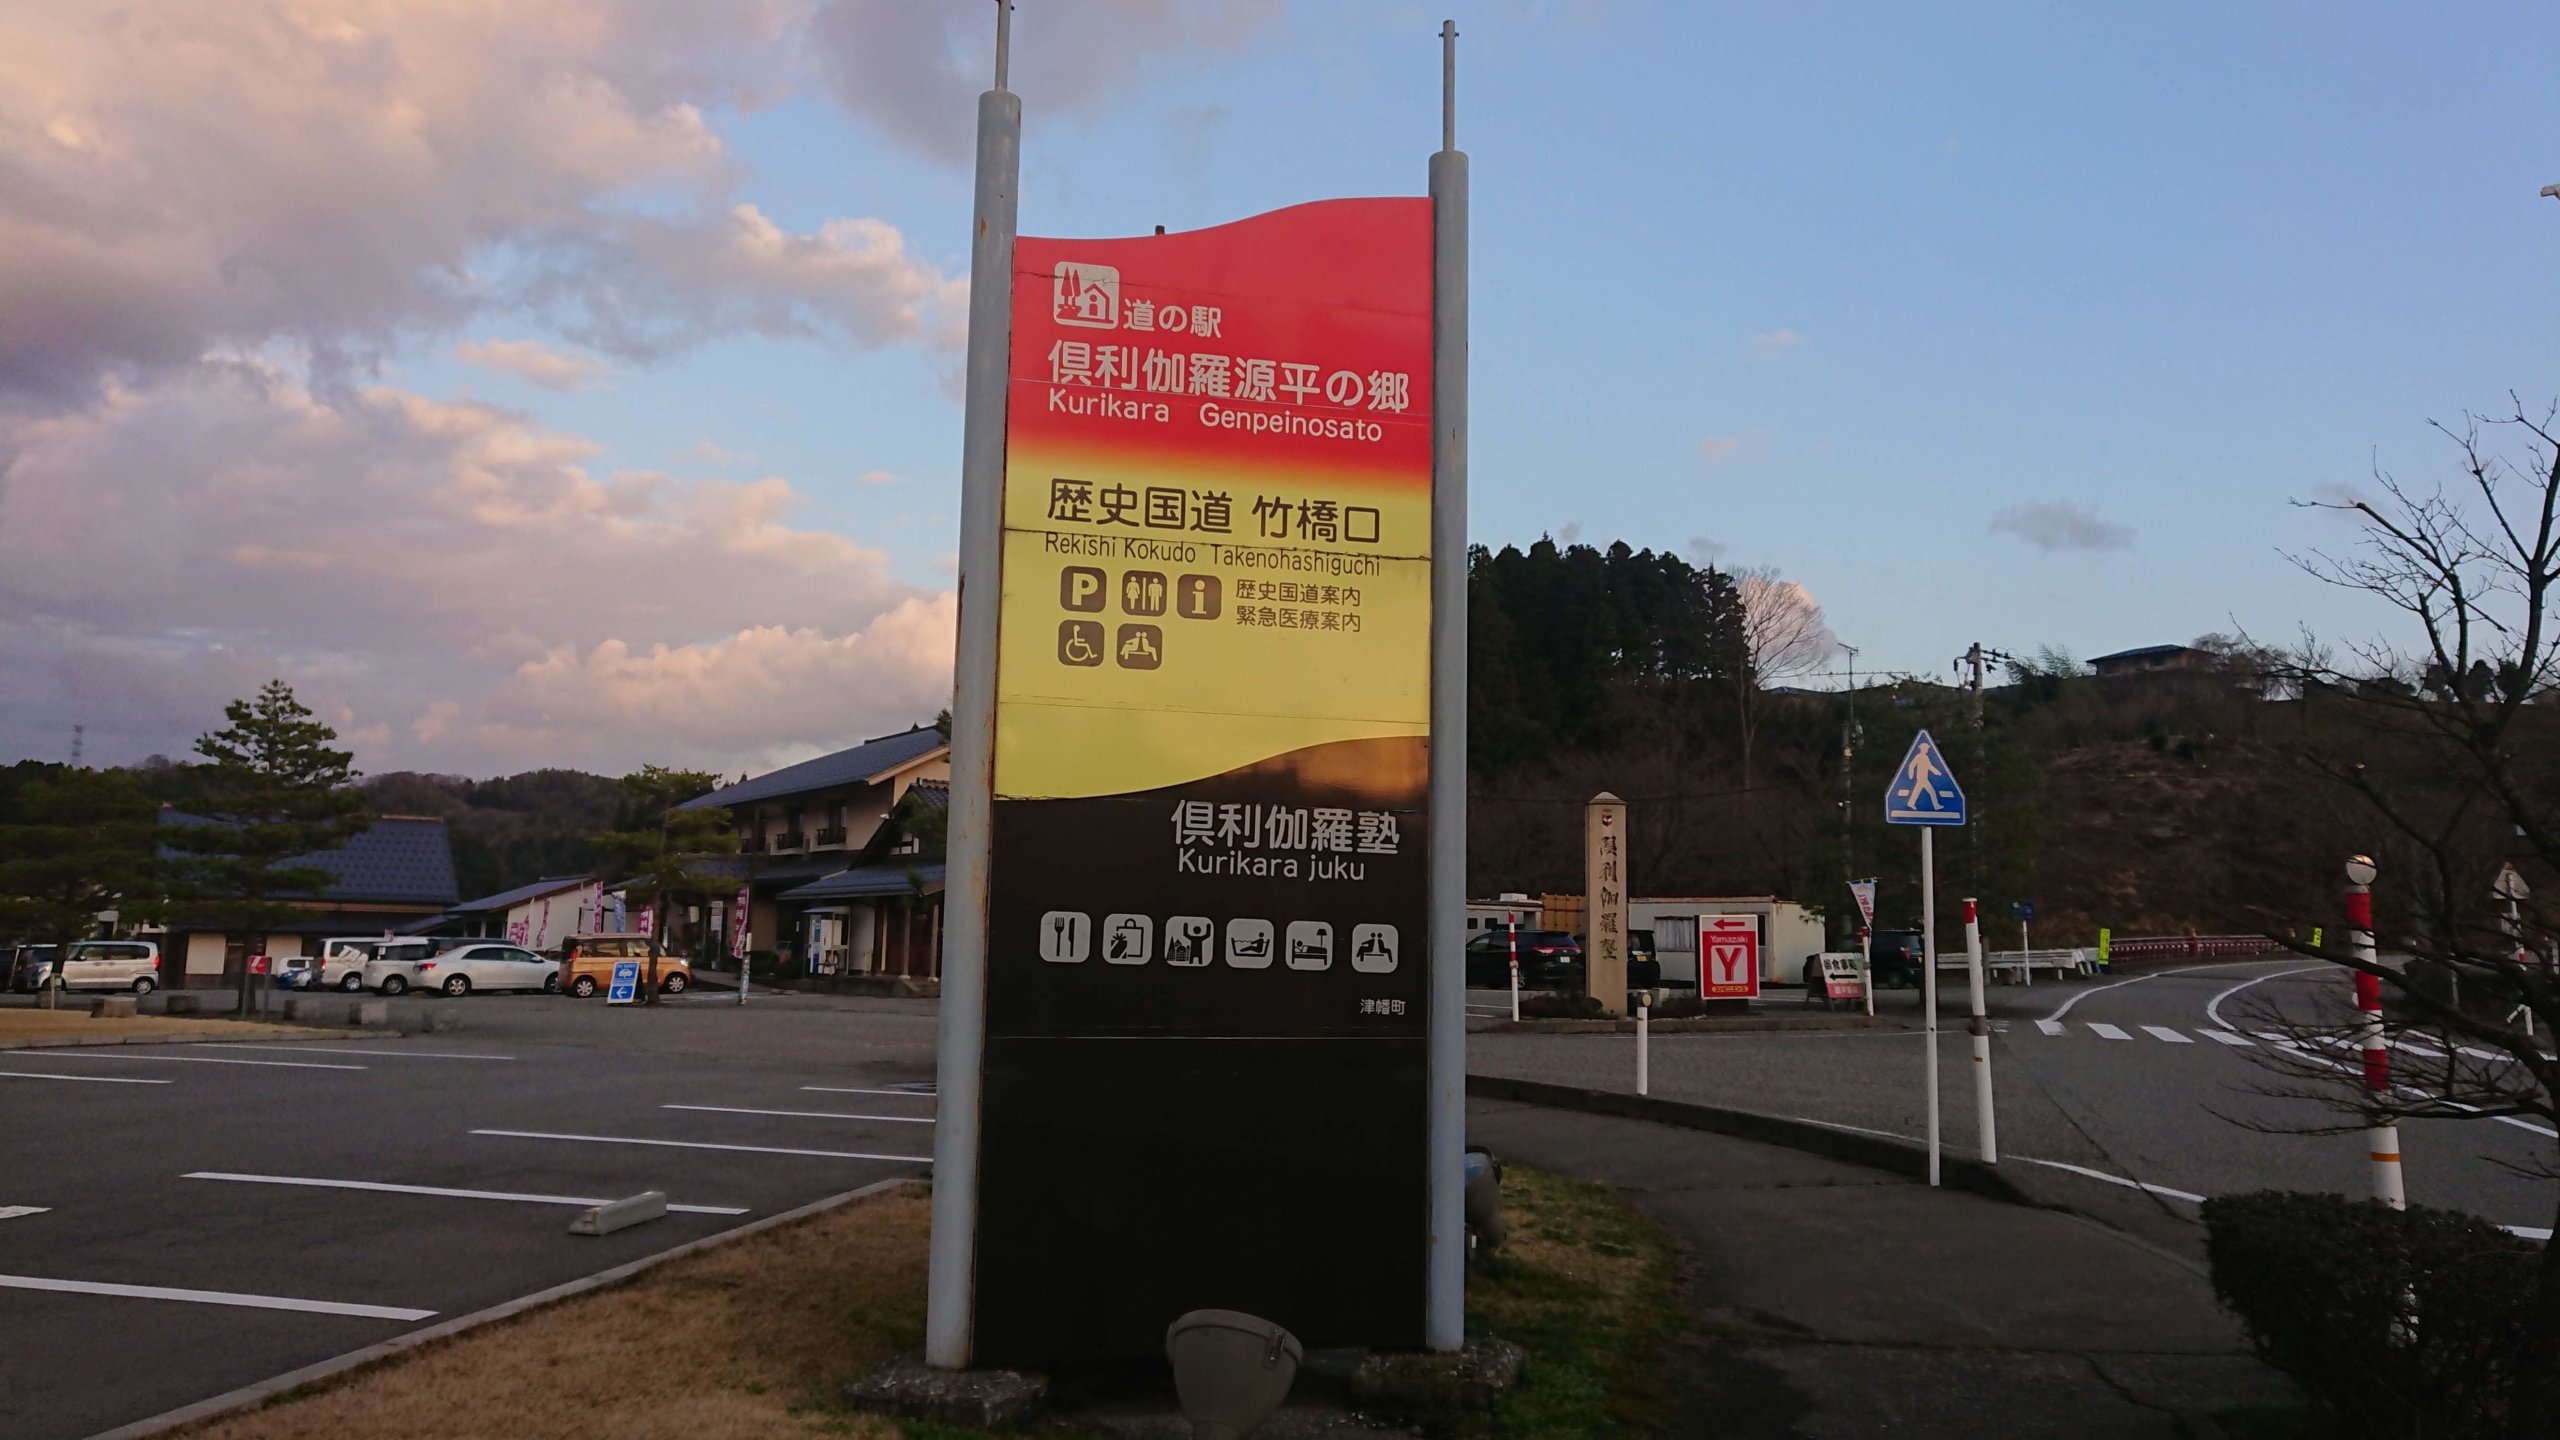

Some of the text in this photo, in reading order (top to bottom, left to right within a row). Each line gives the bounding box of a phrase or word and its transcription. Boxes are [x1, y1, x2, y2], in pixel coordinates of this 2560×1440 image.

[1123, 298, 1222, 338] 道の駅
[1048, 339, 1410, 414] 倶利伽羅源平の郷
[1049, 388, 1382, 442] Kurikara Genpeinosato
[1047, 478, 1380, 544] 歴史国道 竹橋口
[1045, 532, 1381, 577] Rekishi Kokudo Takenohashiguchi
[1236, 579, 1361, 607] 歴史国道案内
[1236, 605, 1361, 633] 緊急医療案内
[1171, 800, 1400, 855] 倶利伽羅塾
[1178, 848, 1365, 882] Kurikara juku
[1710, 935, 1749, 943] Yamazaki
[1360, 998, 1406, 1016] 津幡町
